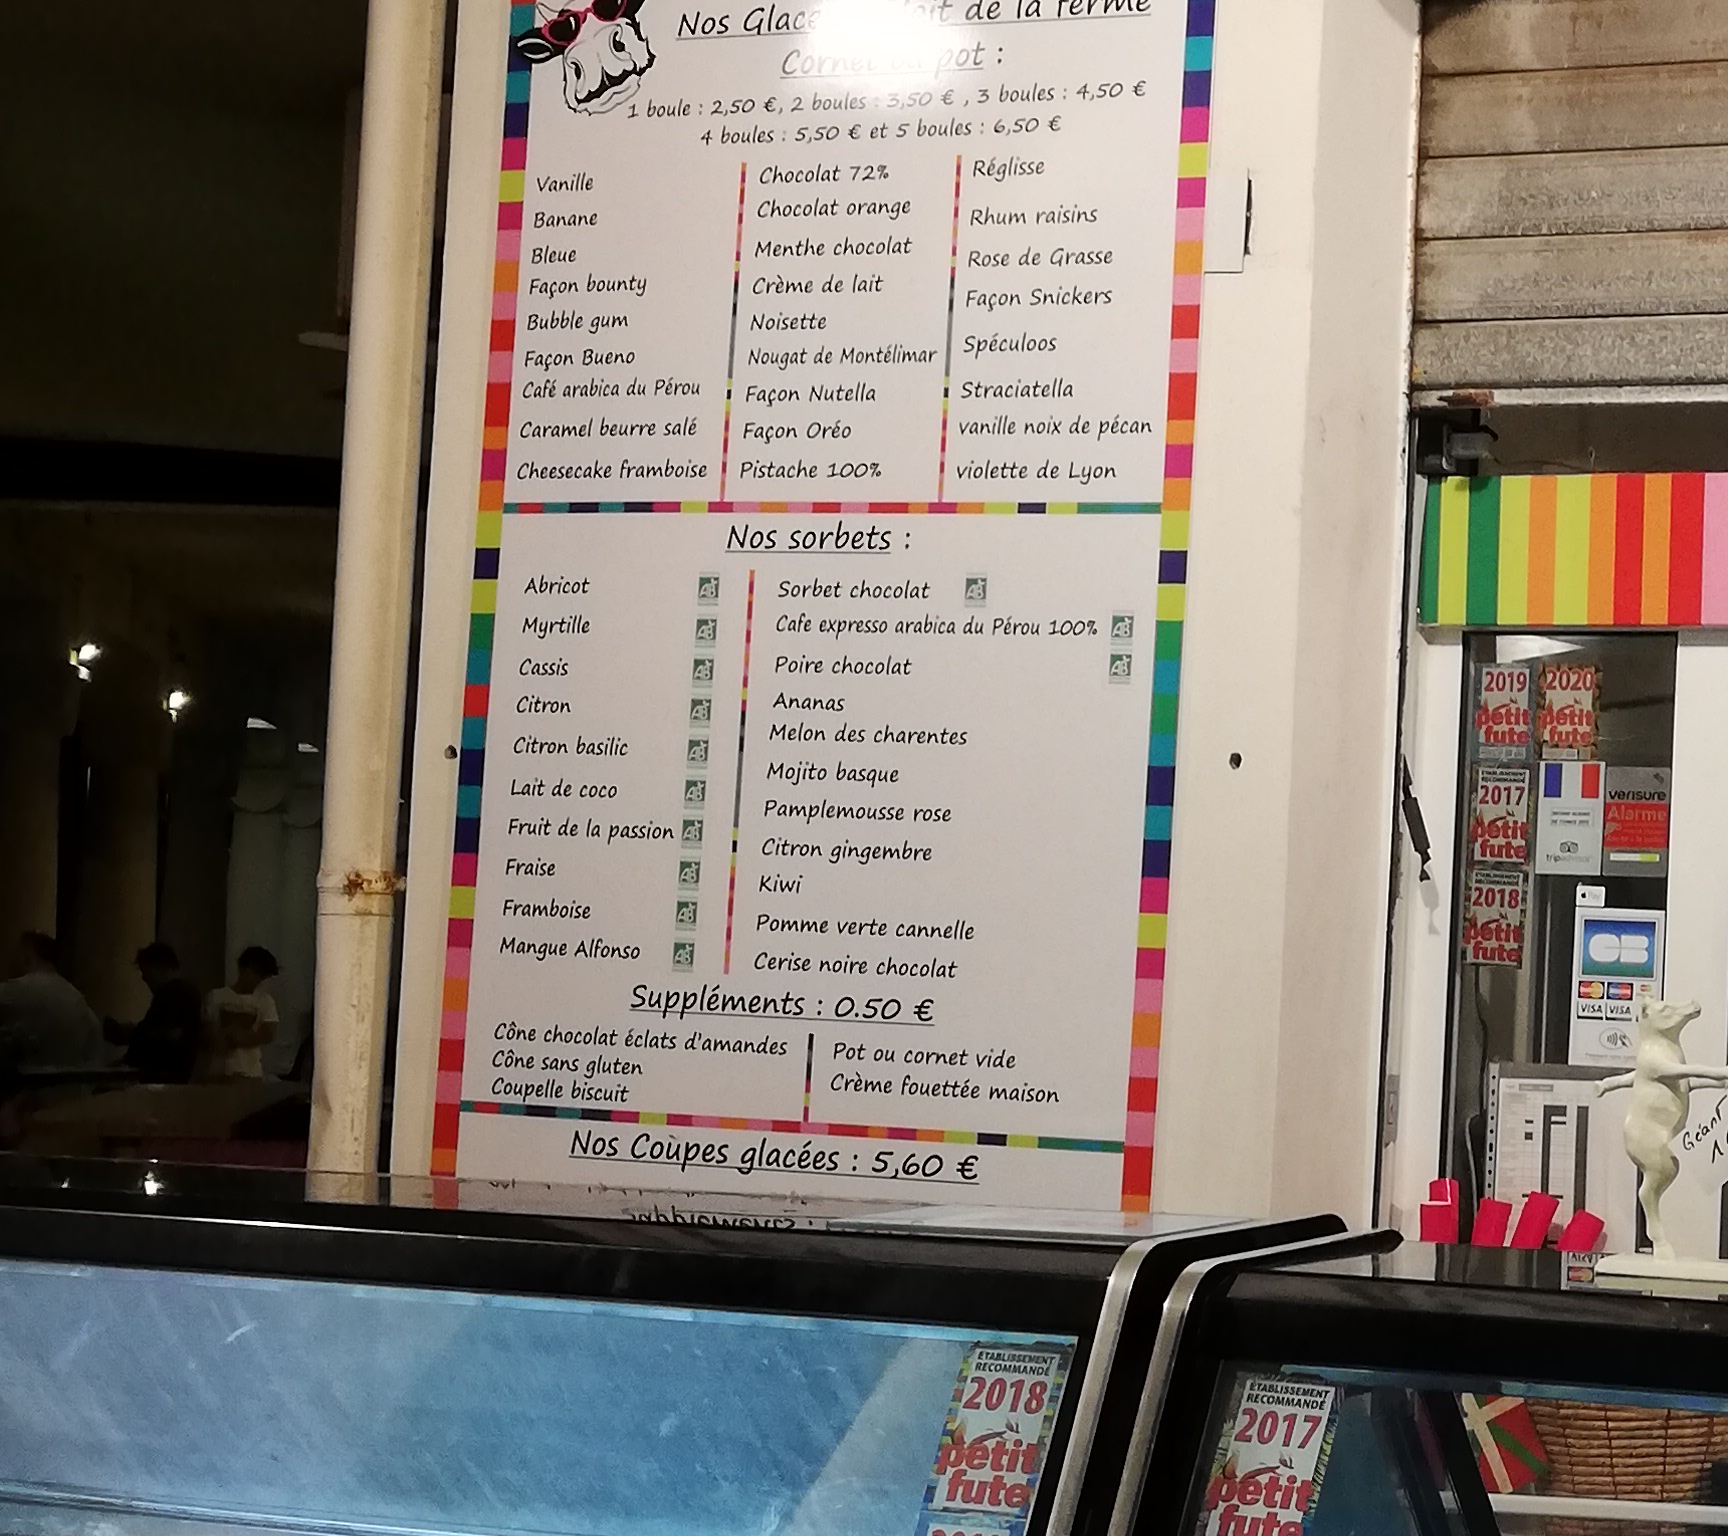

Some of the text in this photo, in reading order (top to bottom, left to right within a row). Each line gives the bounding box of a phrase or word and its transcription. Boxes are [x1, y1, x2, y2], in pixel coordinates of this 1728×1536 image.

[677, 9, 731, 37] Nos
[700, 115, 1062, 146] 4 boules 5,50 € et 5 boules 6,50 €
[536, 171, 594, 193] Vanille
[759, 163, 890, 185] Chocolat 72%
[972, 156, 1045, 183] Réglisse
[533, 211, 598, 229] Banane
[531, 245, 577, 265] Bleue
[529, 272, 647, 300] Façon bounty
[965, 285, 1113, 313] Façon Snickers
[526, 310, 629, 335] Bubble gum
[750, 311, 827, 331] Noisette
[963, 332, 1057, 360] Spéculoos
[524, 348, 635, 372] Façon Bueno
[522, 376, 700, 399] Café arabica du Pérou
[745, 381, 876, 408] Façon Nutella
[960, 377, 1074, 399] Straciatella
[519, 416, 697, 439] Caramel beurre salé
[516, 458, 707, 480] Cheesecake framboise
[956, 459, 1117, 486] violette de Lyon
[726, 524, 891, 551] Nos sorbets
[523, 574, 591, 595] Abricot
[522, 614, 590, 640] Myrtille
[519, 657, 569, 677] Cassis
[1484, 671, 1528, 693] 2019
[1545, 670, 1594, 692] 2020
[769, 721, 968, 746] Melon des charentes
[1479, 784, 1526, 806] 2017
[1608, 790, 1667, 801] verisure
[763, 799, 952, 825] Pamplemousse rose
[1607, 805, 1668, 821] Alarme
[505, 857, 556, 877] Fraise
[758, 873, 804, 894] Kiwi
[502, 897, 591, 920] Framboise
[1472, 887, 1519, 909] 2018
[499, 936, 641, 962] Mangue Alfonso
[1588, 933, 1649, 963] CB
[630, 983, 935, 1022] Suppléments 0.50 €
[1580, 1004, 1632, 1015] VISA VISA
[491, 1076, 630, 1103] Coupelle biscuit
[830, 1071, 1060, 1103] Crème fouettée maison
[570, 1129, 980, 1181] Nos Coupes glacées 5,60 €
[962, 1377, 1047, 1414] 2018
[1233, 1407, 1322, 1450] 2017
[936, 1439, 1039, 1475] petit
[1206, 1475, 1314, 1512] petit
